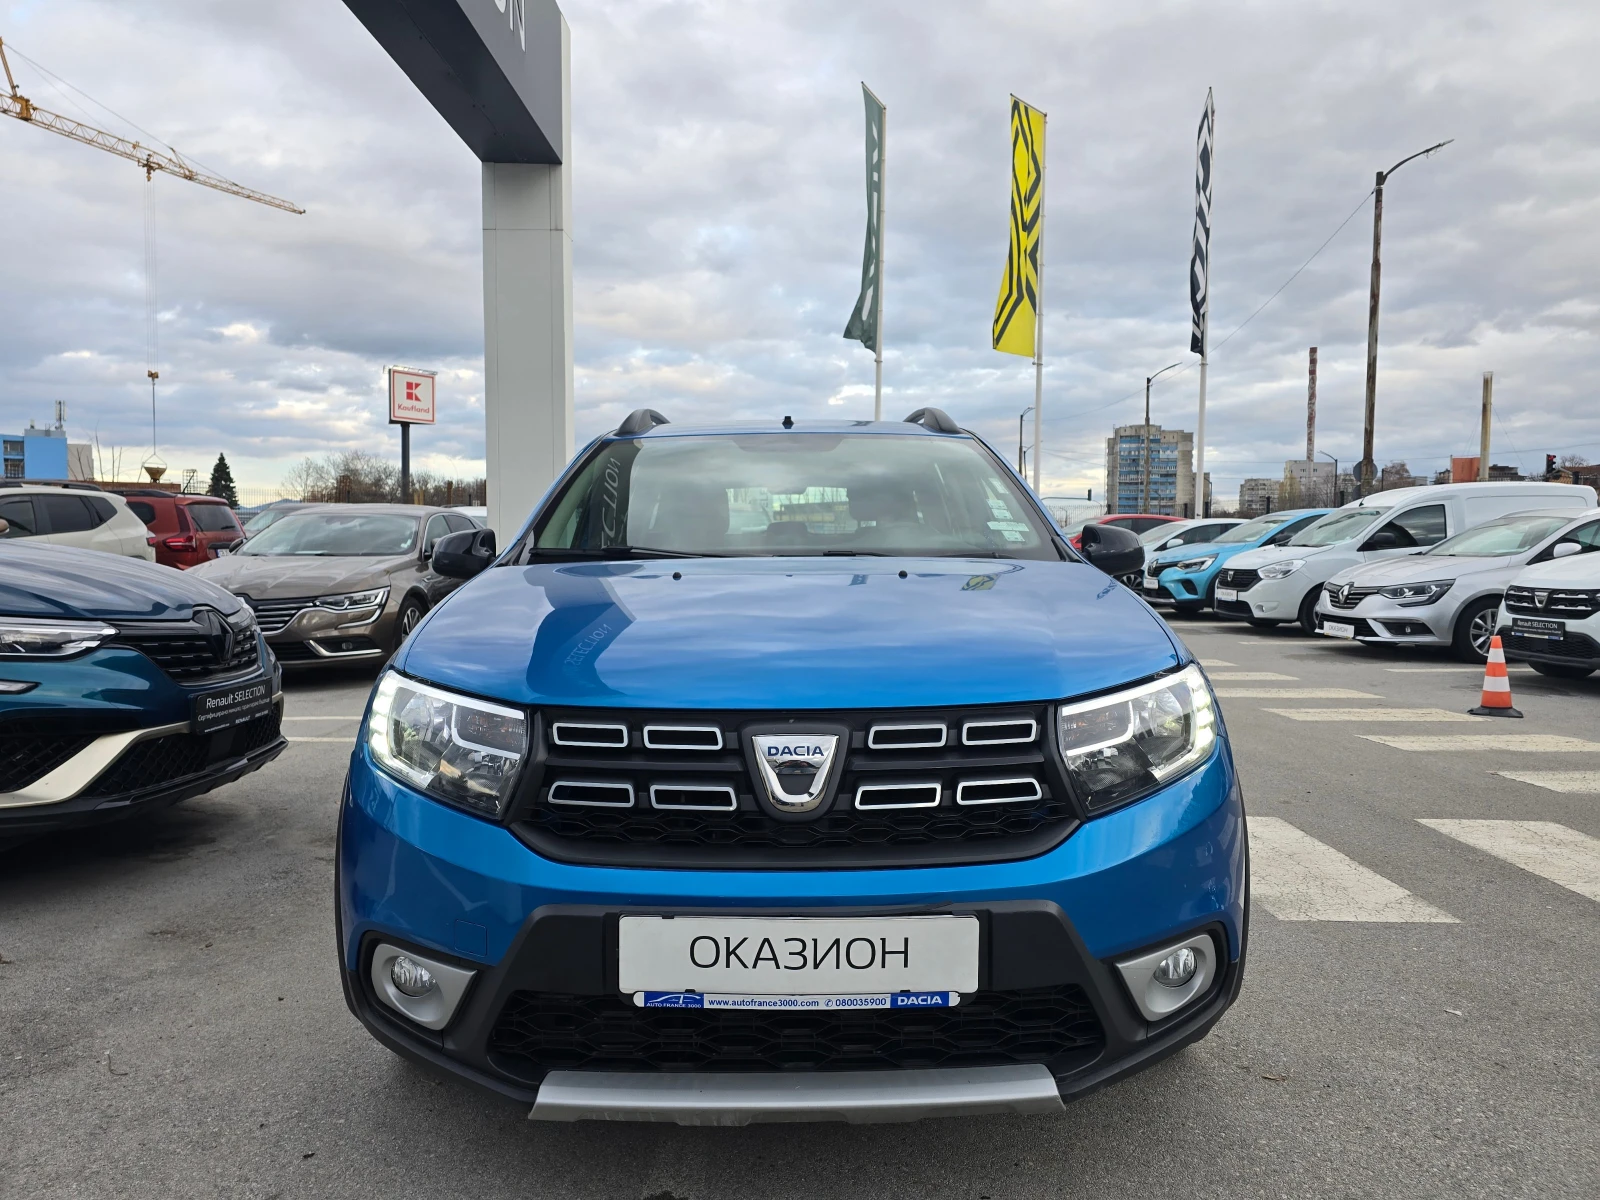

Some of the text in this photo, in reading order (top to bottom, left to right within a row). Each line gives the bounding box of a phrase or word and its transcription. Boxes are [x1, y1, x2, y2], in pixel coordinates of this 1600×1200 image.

[397, 403, 430, 414] Kaufland
[1532, 621, 1558, 629] SELECTION
[206, 684, 266, 709] Renault SELECTION
[767, 745, 824, 757] DACIA
[689, 935, 910, 970] ОКАЗИОН
[708, 997, 887, 1008] www.autofrance3000.com 080035900
[898, 995, 943, 1006] DACIA
